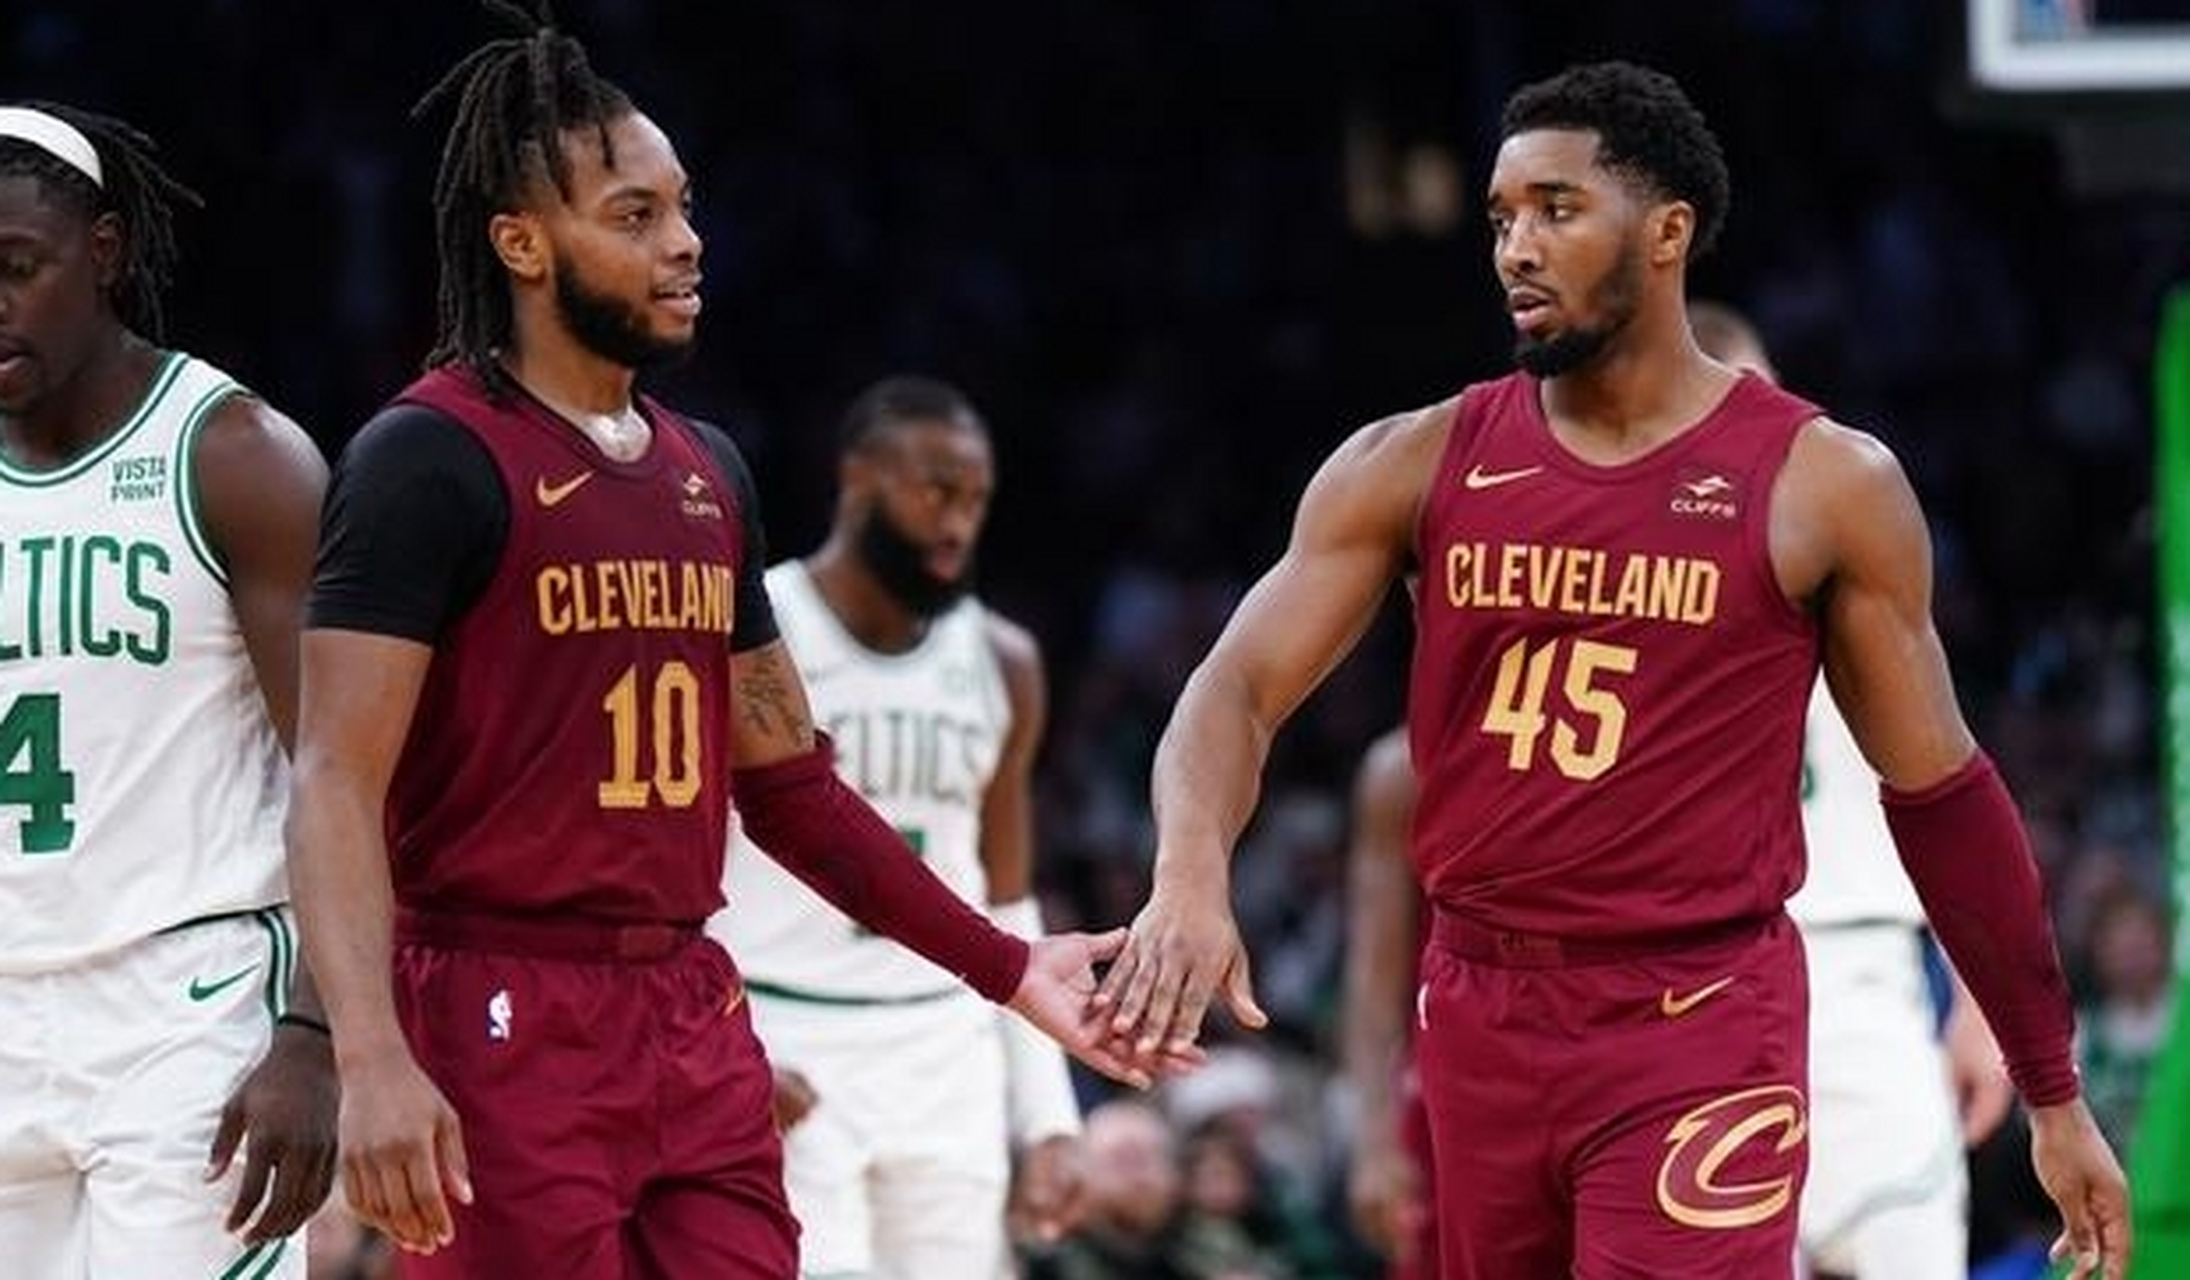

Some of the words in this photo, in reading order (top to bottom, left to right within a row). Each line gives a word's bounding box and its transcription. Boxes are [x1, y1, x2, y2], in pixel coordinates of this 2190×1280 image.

[1447, 543, 1720, 625] CLEVELAND
[0, 693, 74, 854] 4
[599, 660, 701, 809] 10
[1480, 637, 1639, 782] 45
